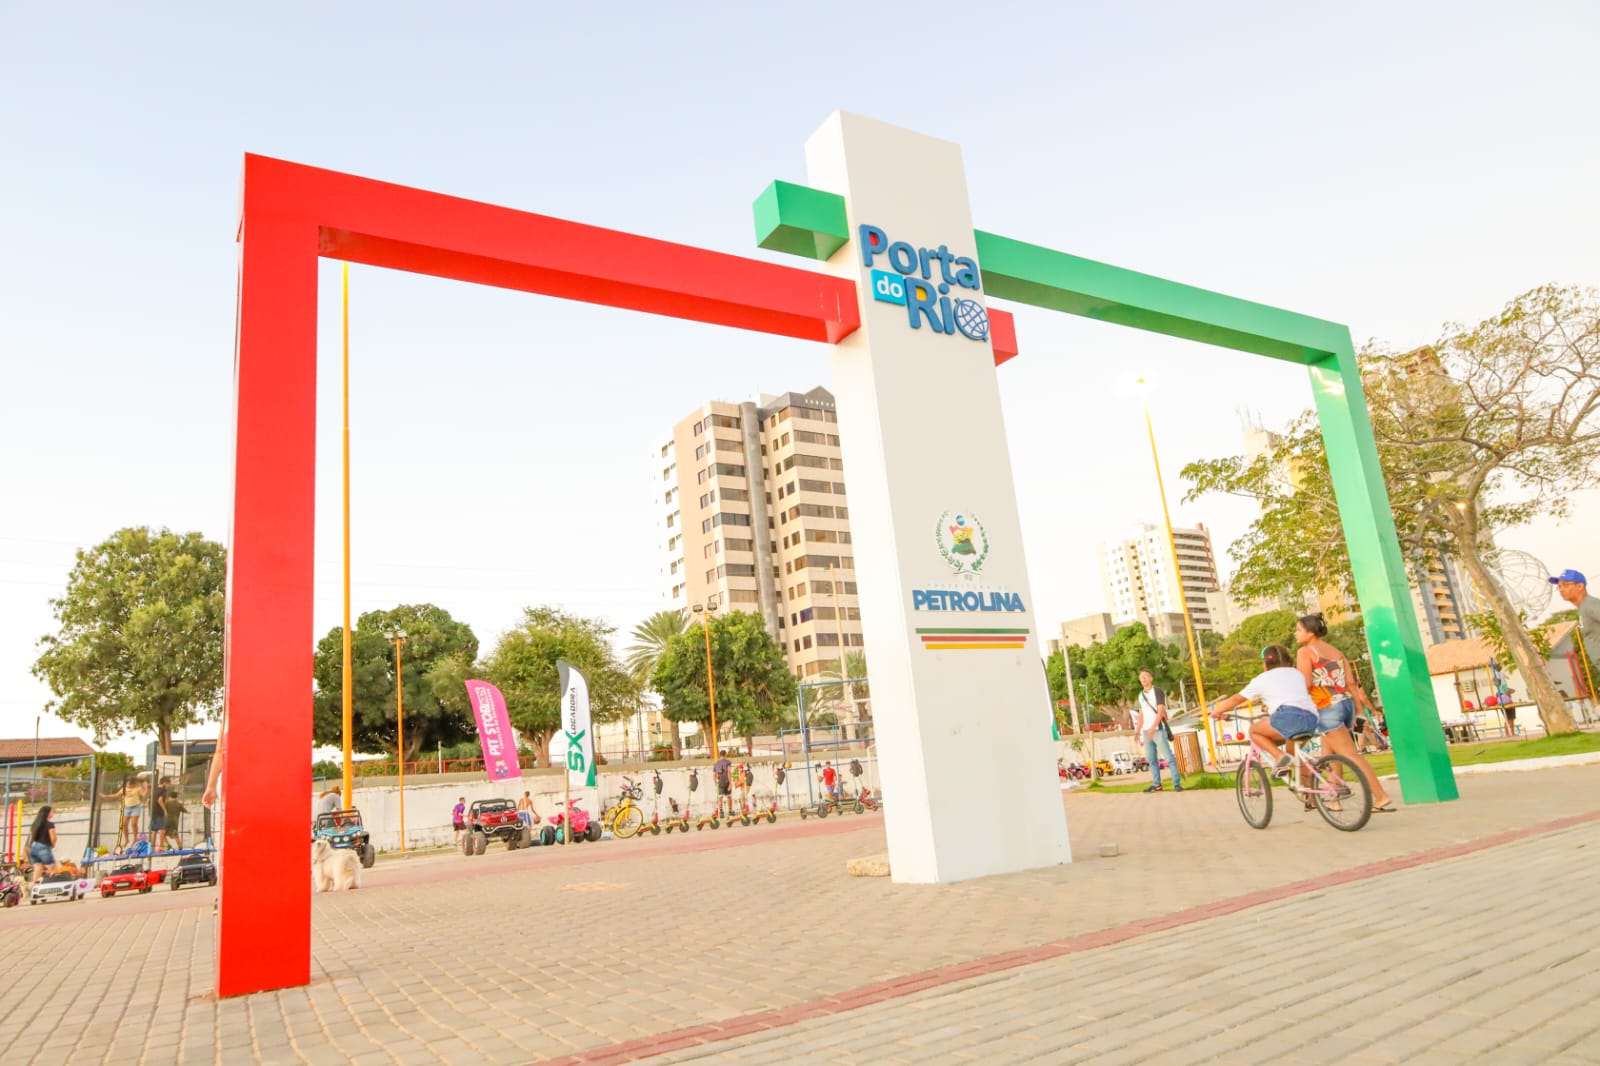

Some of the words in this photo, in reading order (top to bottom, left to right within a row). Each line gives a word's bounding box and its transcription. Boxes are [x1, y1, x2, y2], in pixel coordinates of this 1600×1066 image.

[859, 224, 981, 290] Porta
[877, 275, 903, 298] do
[912, 589, 1025, 612] PETROLINA
[481, 706, 498, 736] STOP
[487, 738, 501, 756] PIT
[565, 729, 585, 773] SX
